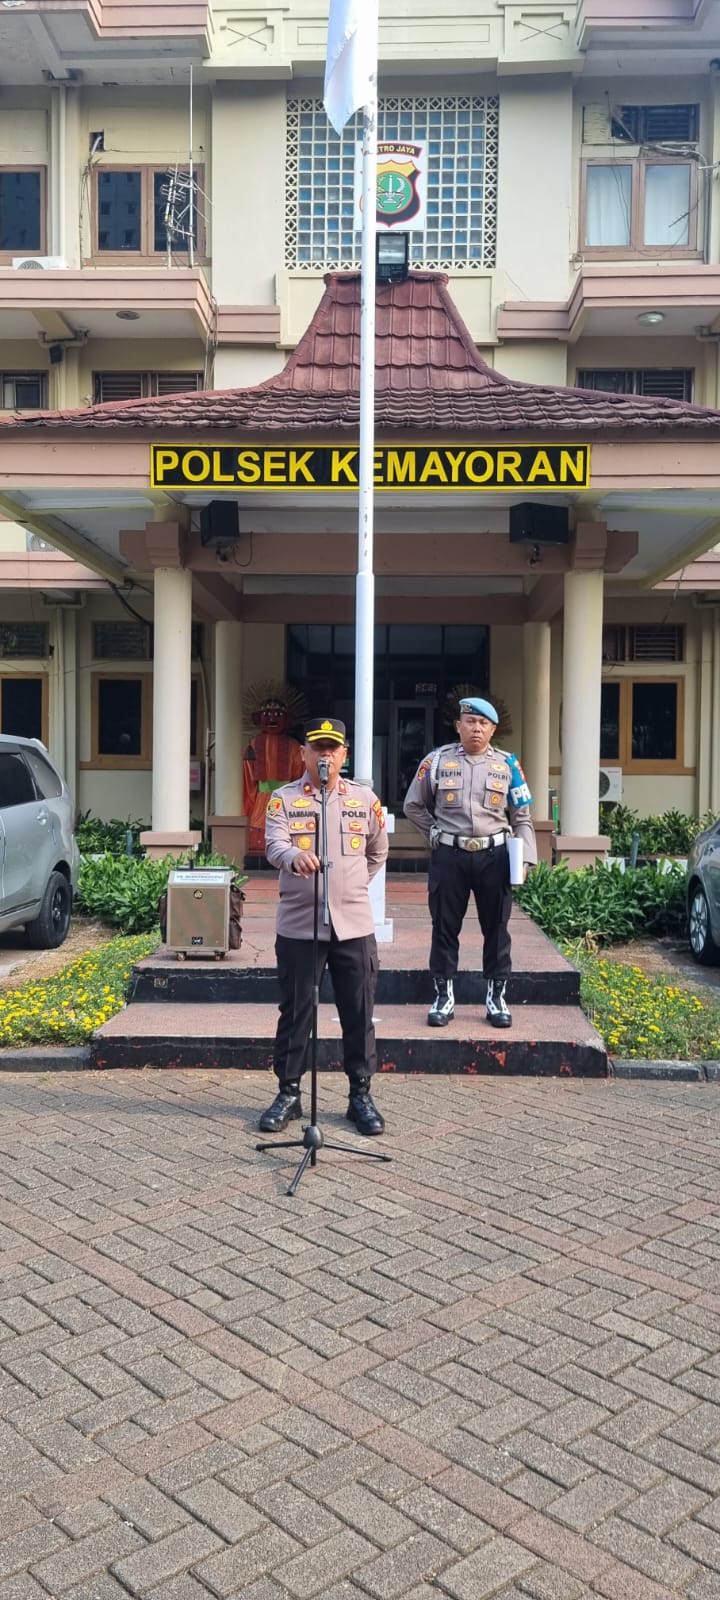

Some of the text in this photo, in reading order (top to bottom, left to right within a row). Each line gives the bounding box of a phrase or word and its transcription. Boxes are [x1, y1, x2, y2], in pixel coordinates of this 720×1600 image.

[396, 145, 415, 155] JAYA
[155, 450, 316, 482] POLSEK
[440, 770, 462, 778] ELFIN
[487, 771, 508, 781] POLRI
[341, 810, 367, 819] POLRI
